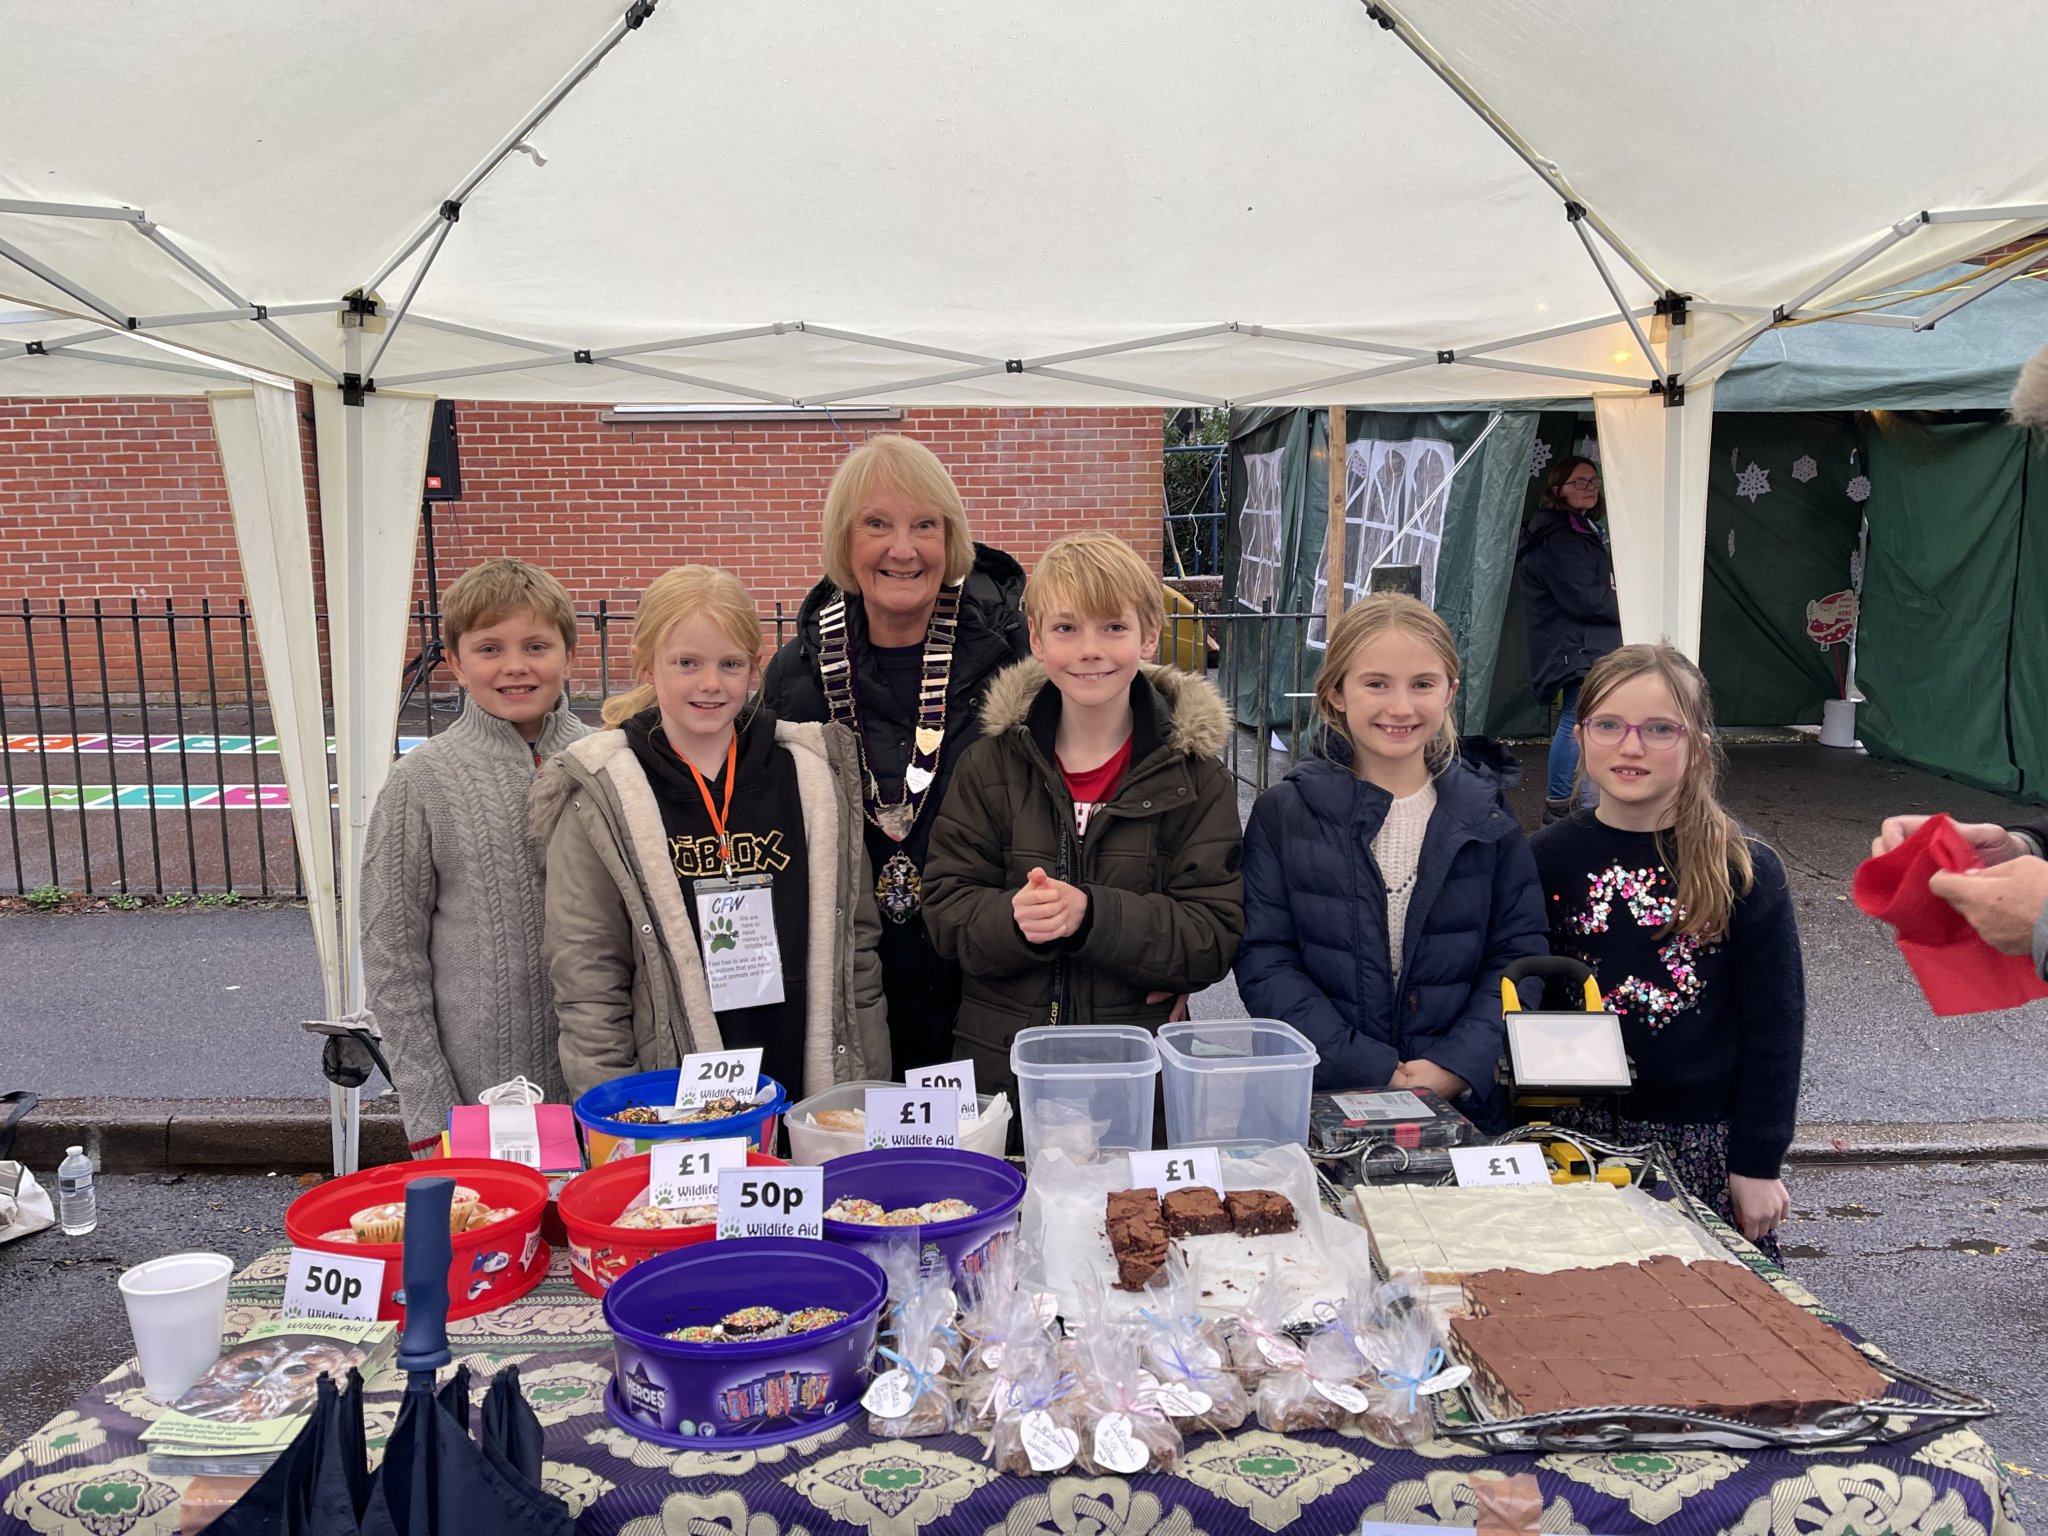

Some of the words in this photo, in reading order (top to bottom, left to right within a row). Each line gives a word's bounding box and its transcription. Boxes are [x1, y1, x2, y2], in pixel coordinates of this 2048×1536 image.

[698, 1061, 745, 1083] 20p
[700, 1088, 736, 1099] Wildlife
[737, 1086, 754, 1097] Aid
[900, 1101, 931, 1124] £1
[960, 1102, 975, 1114] Aid
[891, 1134, 933, 1147] Wildlife
[935, 1134, 954, 1147] Aid
[678, 1152, 711, 1176] £1
[1165, 1159, 1196, 1182] £1
[1488, 1156, 1521, 1176] £1
[677, 1184, 719, 1198] Wildlife
[740, 1181, 804, 1215] 50p
[747, 1223, 795, 1236] Wildlife
[798, 1223, 819, 1236] Aid
[304, 1265, 362, 1305] 50p
[287, 1322, 337, 1332] Wildlife
[625, 1376, 666, 1409] HEROES
